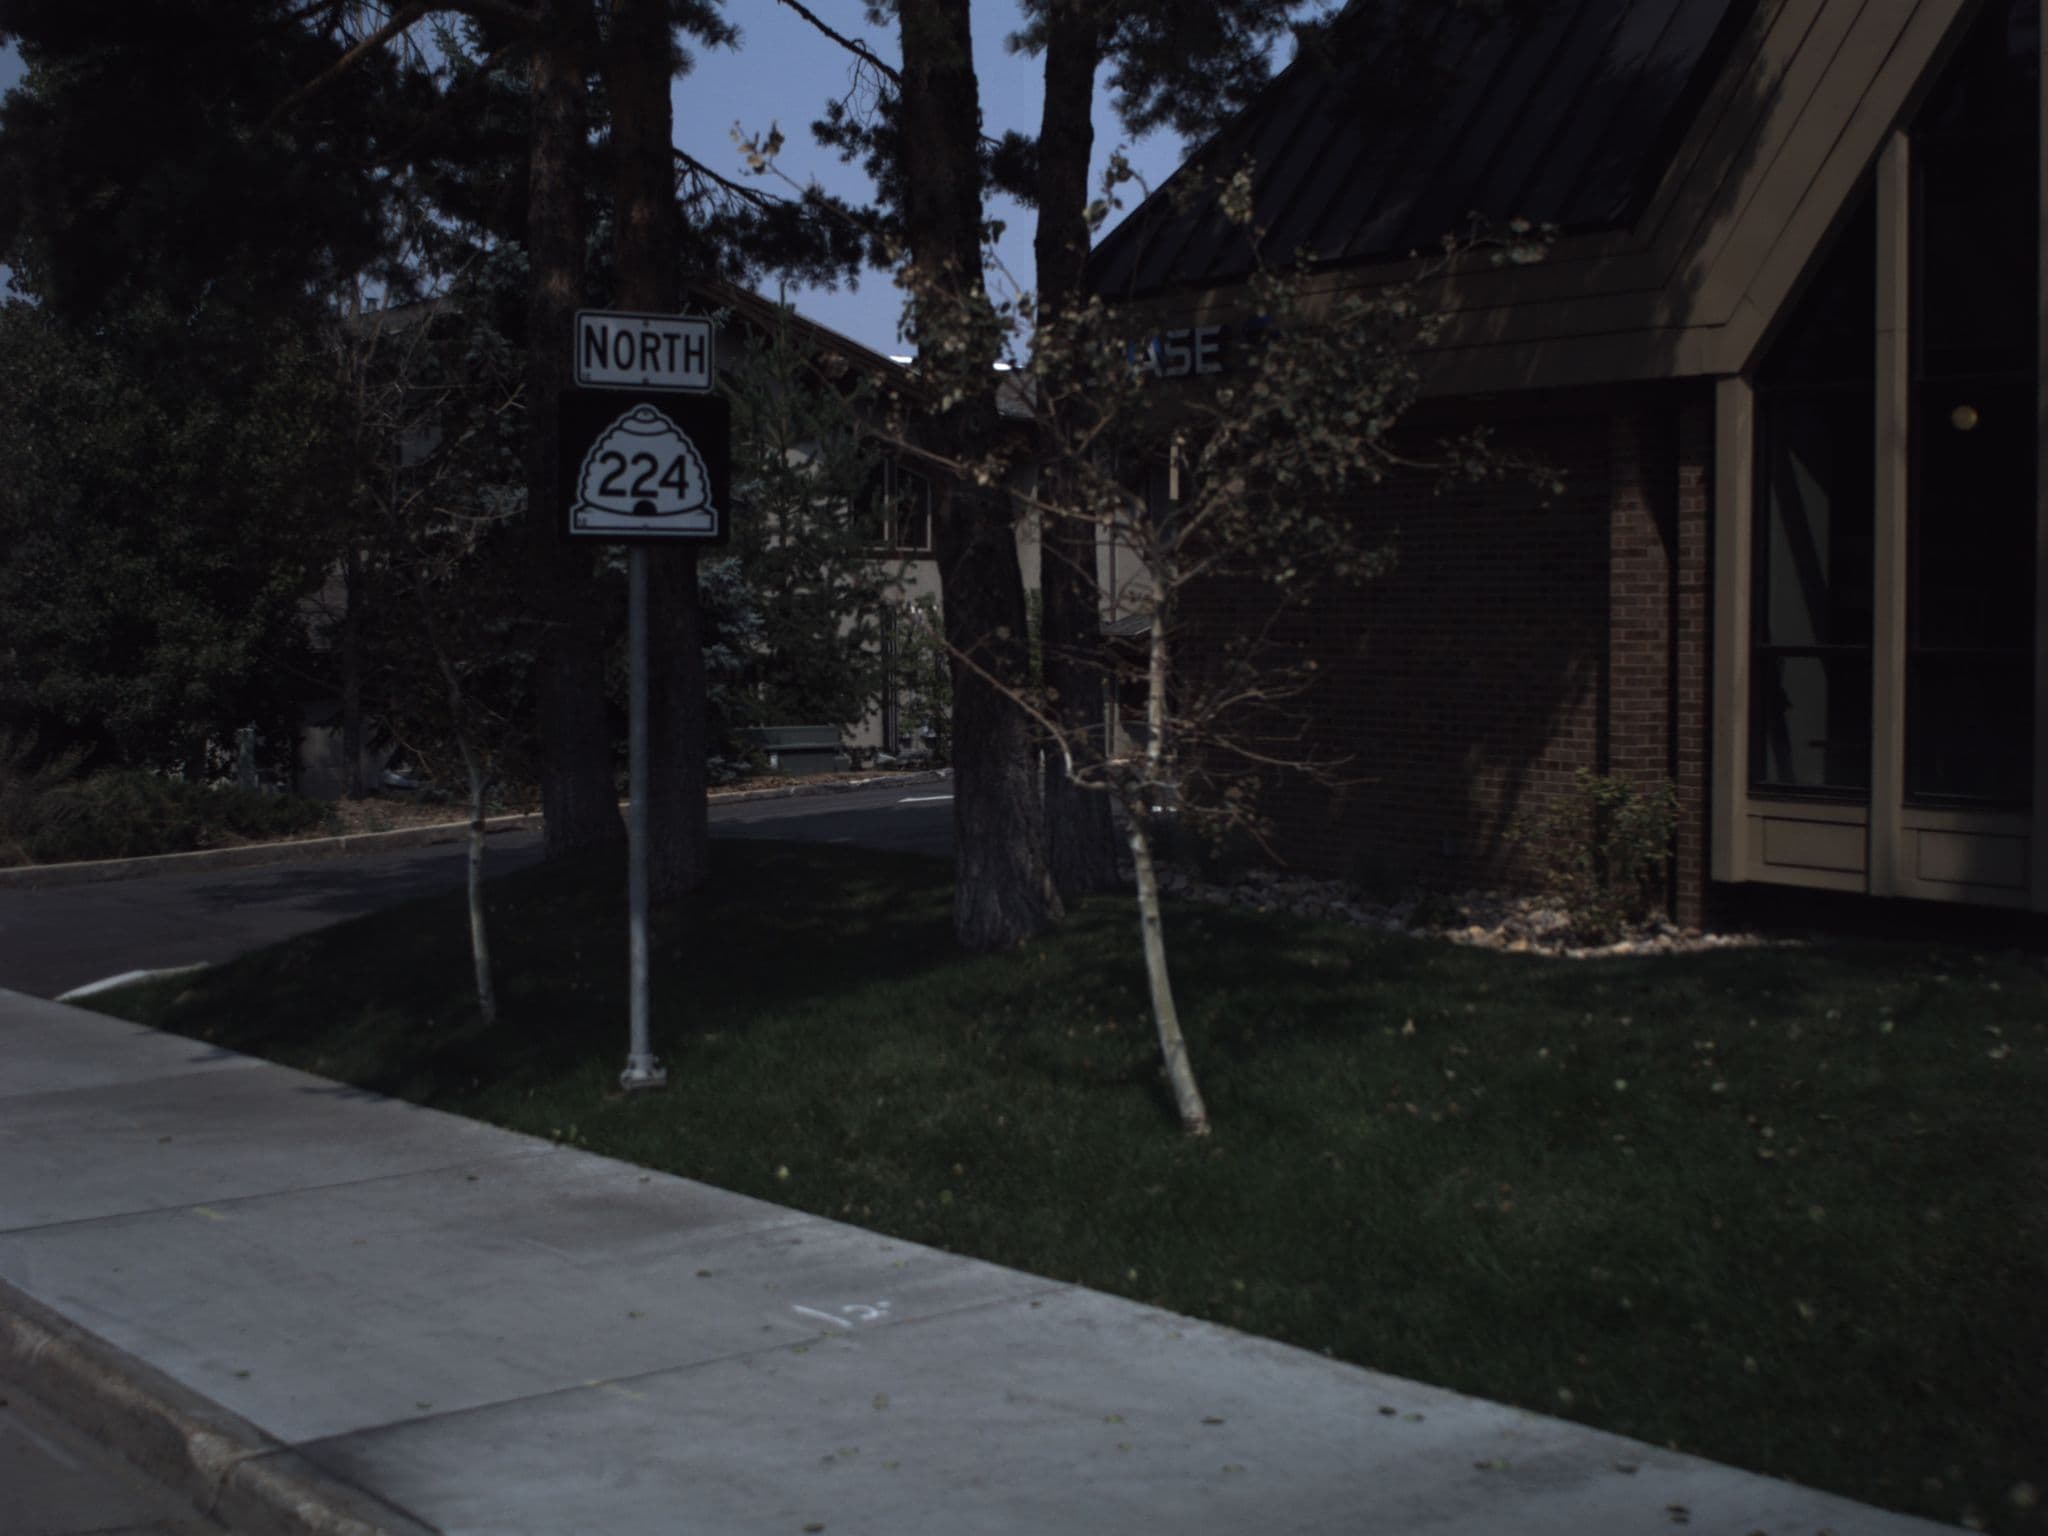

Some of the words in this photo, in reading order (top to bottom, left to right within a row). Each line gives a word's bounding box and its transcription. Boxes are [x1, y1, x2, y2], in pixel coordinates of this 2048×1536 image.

[584, 324, 705, 374] NORTH
[1126, 326, 1224, 378] ASE
[598, 451, 688, 499] 224
